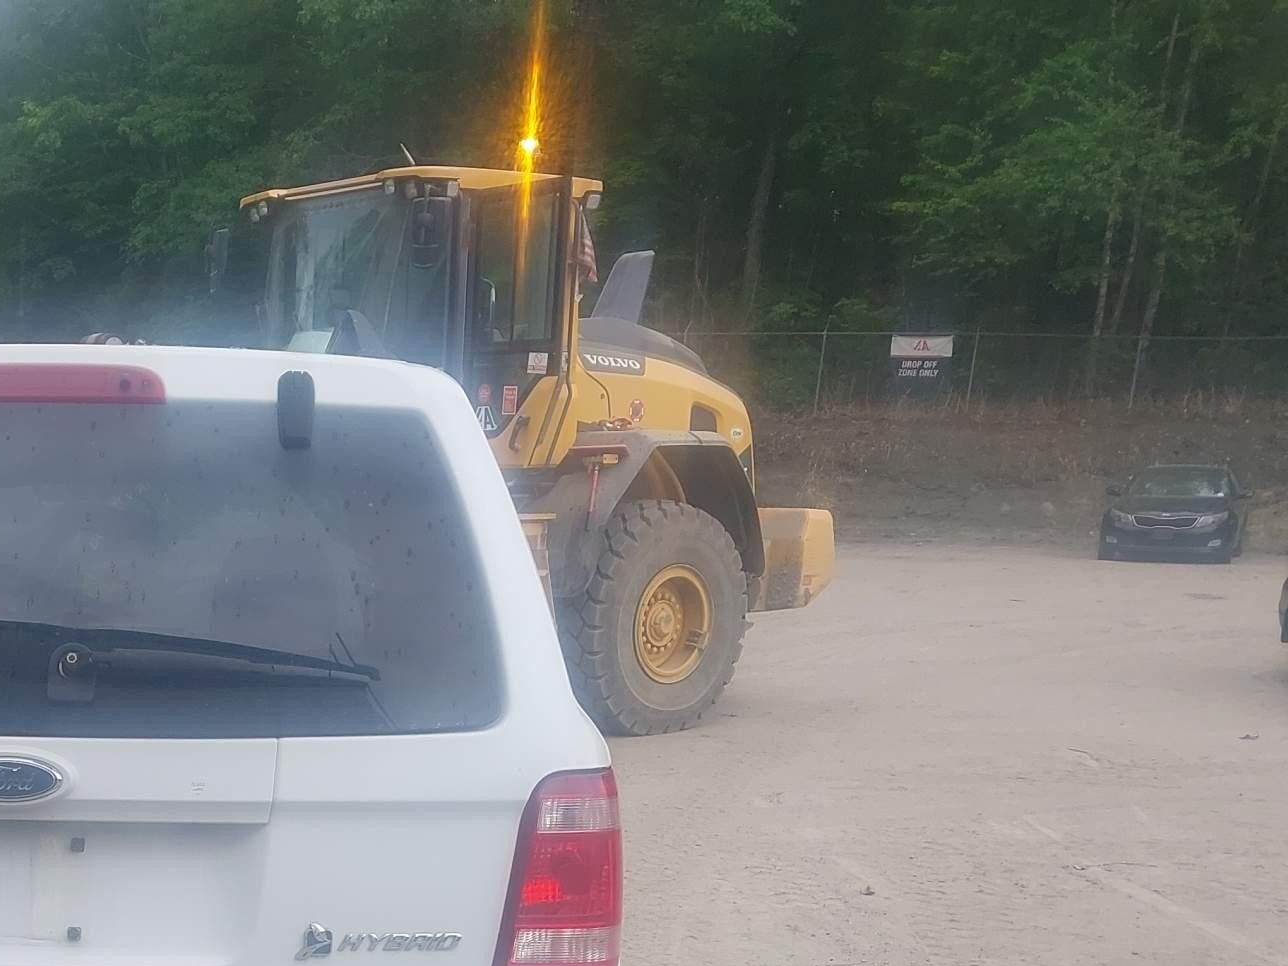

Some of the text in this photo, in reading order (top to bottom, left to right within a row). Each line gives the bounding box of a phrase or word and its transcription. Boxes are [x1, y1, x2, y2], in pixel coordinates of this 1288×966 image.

[584, 353, 641, 369] VOLVO
[902, 360, 937, 368] DROP OFF
[919, 369, 939, 377] ONLY
[337, 932, 462, 951] HYBRID
